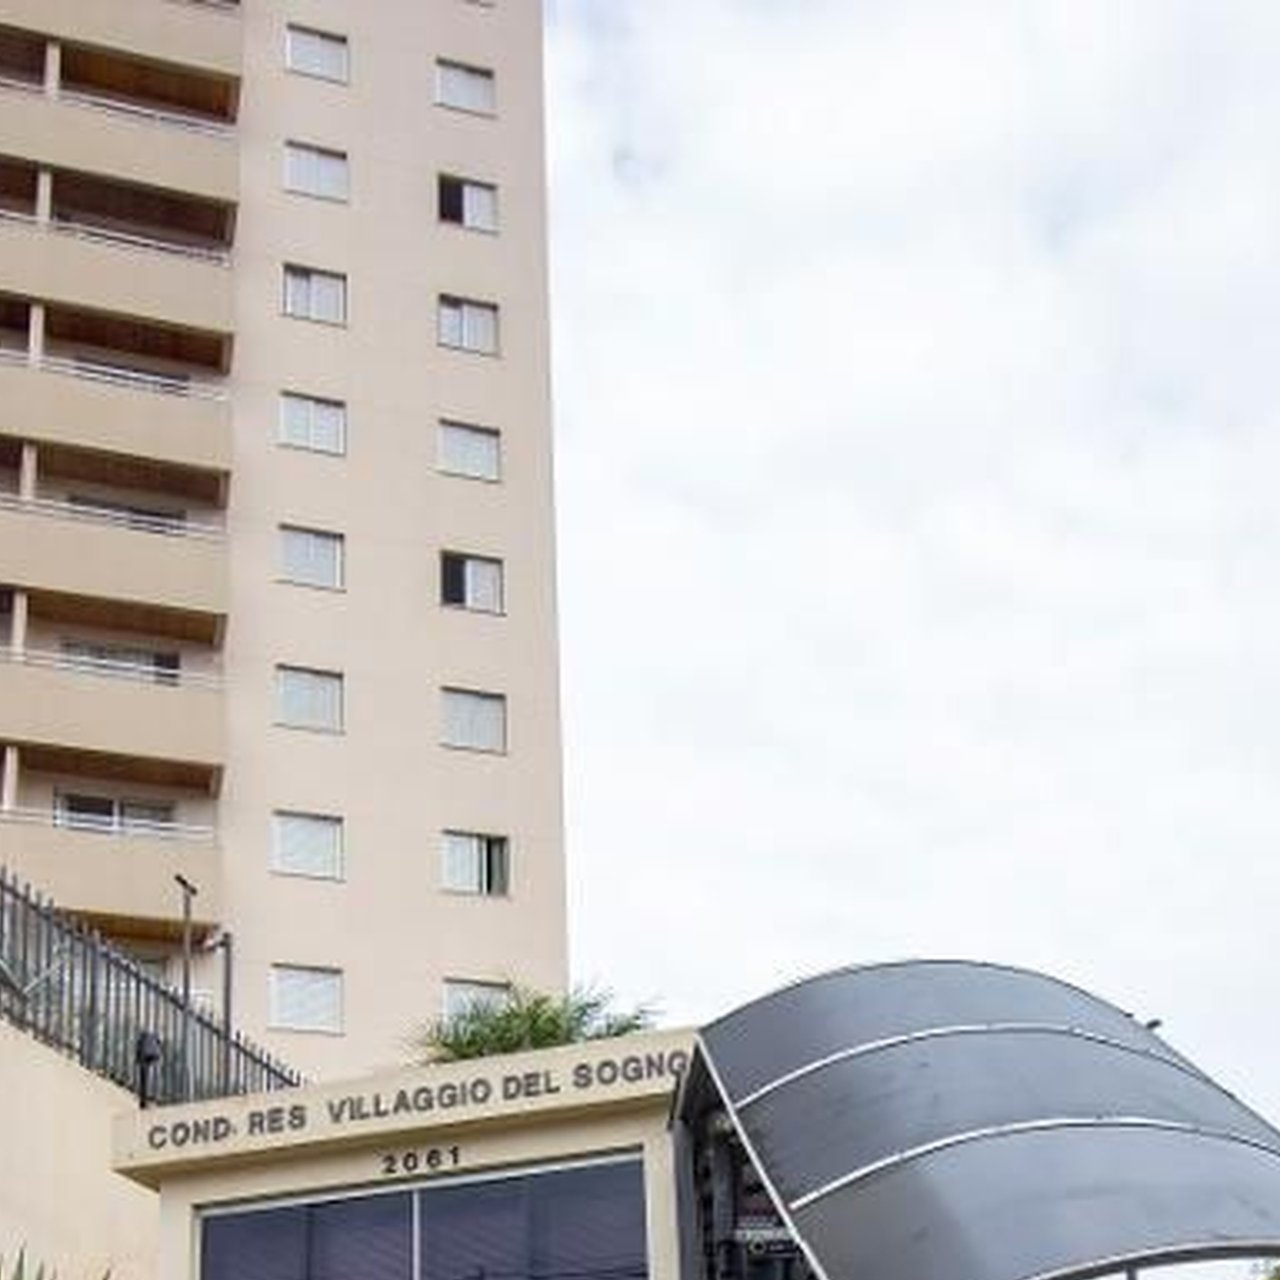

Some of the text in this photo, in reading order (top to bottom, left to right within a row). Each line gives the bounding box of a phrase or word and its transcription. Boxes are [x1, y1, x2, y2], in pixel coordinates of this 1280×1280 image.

[248, 1105, 308, 1136] RES
[327, 1078, 493, 1124] VILLAGGIO
[502, 1072, 561, 1101] DEL
[572, 1051, 688, 1089] SOGNO
[382, 1146, 460, 1174] 2061
